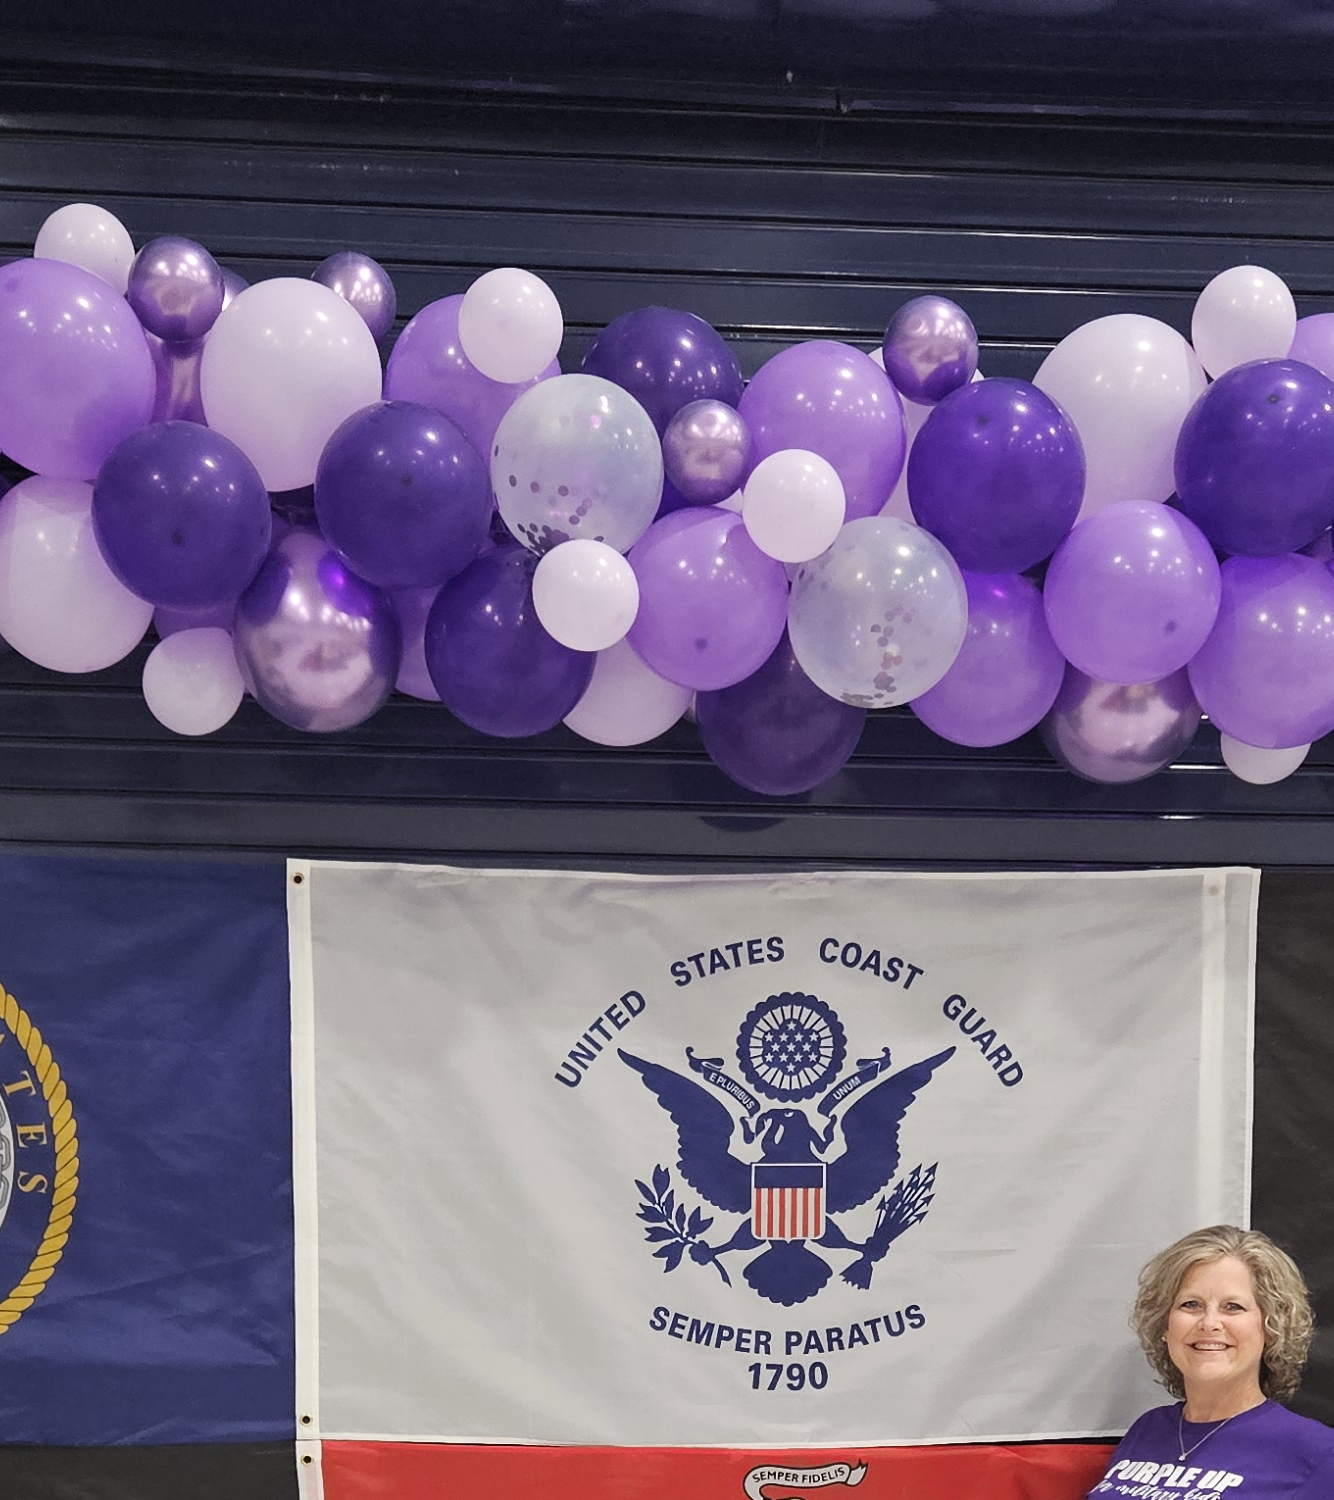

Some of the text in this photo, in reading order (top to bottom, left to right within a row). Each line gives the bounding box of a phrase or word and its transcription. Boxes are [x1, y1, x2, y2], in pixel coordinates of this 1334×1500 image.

[554, 936, 1024, 1088] UNITED STATES COAST GUARD
[716, 1077, 755, 1110] PLURIBUS
[832, 1076, 861, 1100] UNUM
[649, 1304, 926, 1355] SEMPER PARATUS
[748, 1362, 828, 1391] 1790
[752, 1467, 845, 1484] SEMPER FIDELIS
[1104, 1459, 1244, 1492] PURPLE UP
